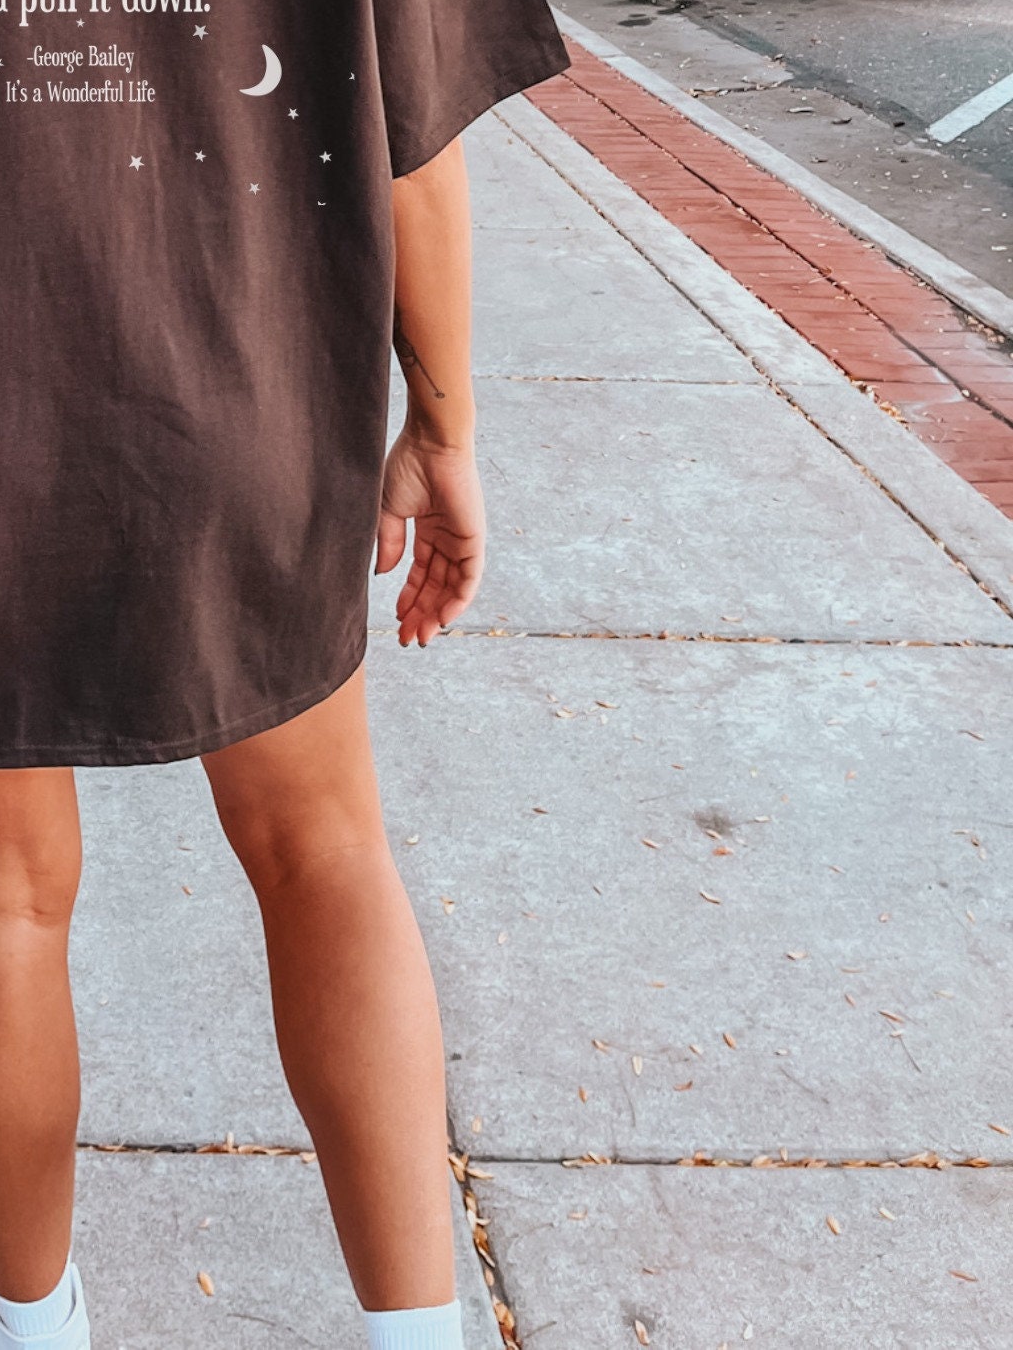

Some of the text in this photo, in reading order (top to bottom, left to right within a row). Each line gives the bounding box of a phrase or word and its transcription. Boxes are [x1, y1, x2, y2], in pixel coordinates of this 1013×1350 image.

[26, 44, 135, 74] -George Bailey
[6, 80, 156, 103] It's a Wonderful Life
